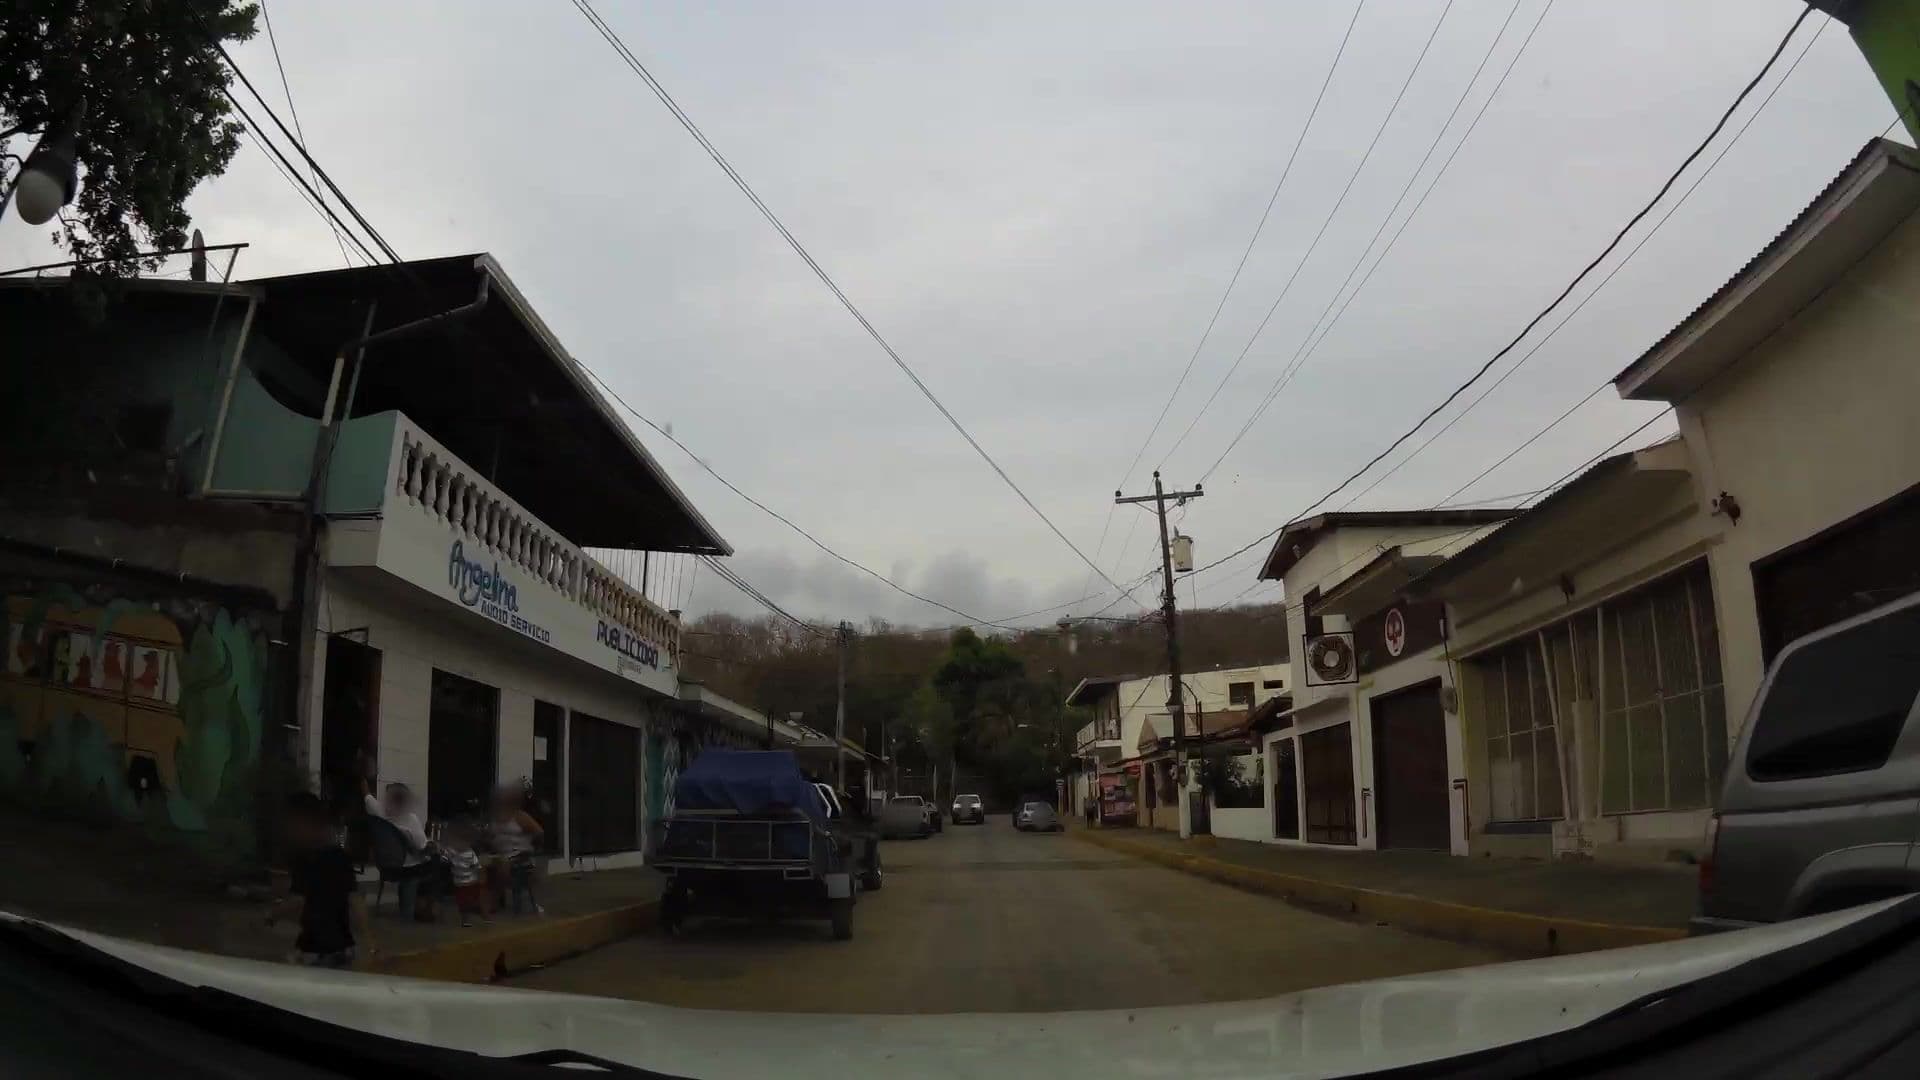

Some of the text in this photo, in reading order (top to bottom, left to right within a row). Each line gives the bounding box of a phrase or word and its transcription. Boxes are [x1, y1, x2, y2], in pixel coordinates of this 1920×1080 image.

[449, 540, 519, 612] Angelina
[481, 600, 550, 643] AUDIO SERVICIO
